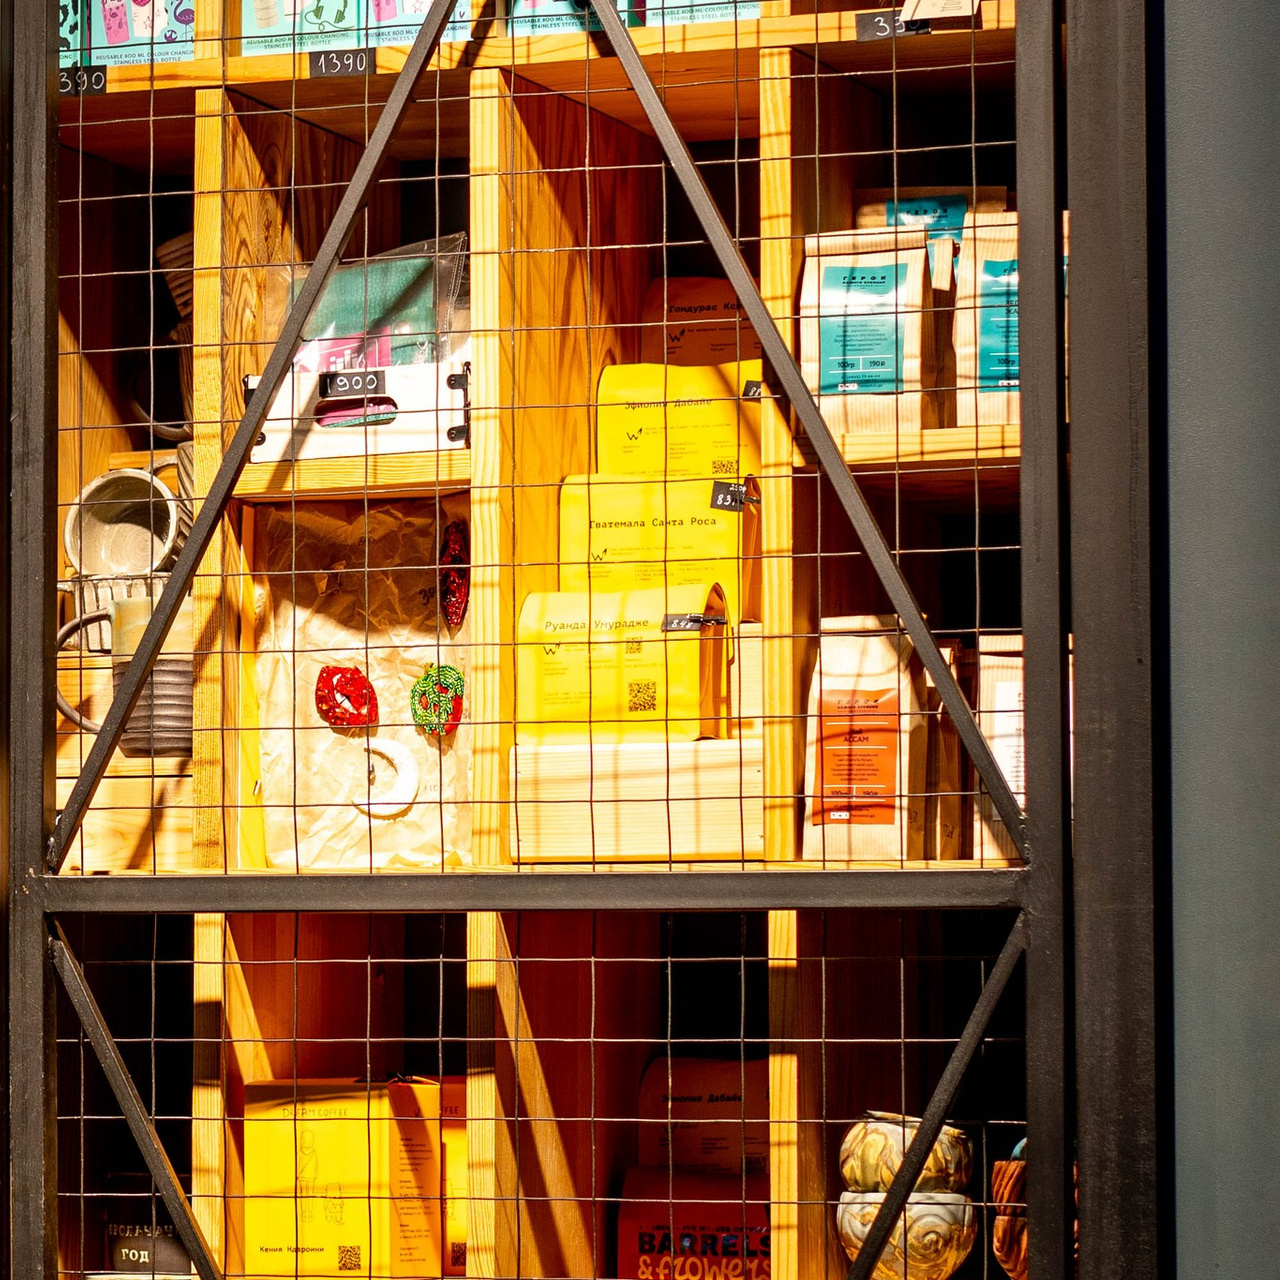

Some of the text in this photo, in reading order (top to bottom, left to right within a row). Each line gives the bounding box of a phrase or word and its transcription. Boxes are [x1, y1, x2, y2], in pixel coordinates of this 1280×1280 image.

[318, 52, 366, 74] 1390
[327, 374, 378, 394] 1900
[589, 517, 717, 530] Гватемала Санта Роса
[545, 619, 650, 632] Руанда Умурадже
[638, 1231, 770, 1257] BARRELS
[121, 1248, 149, 1263] год
